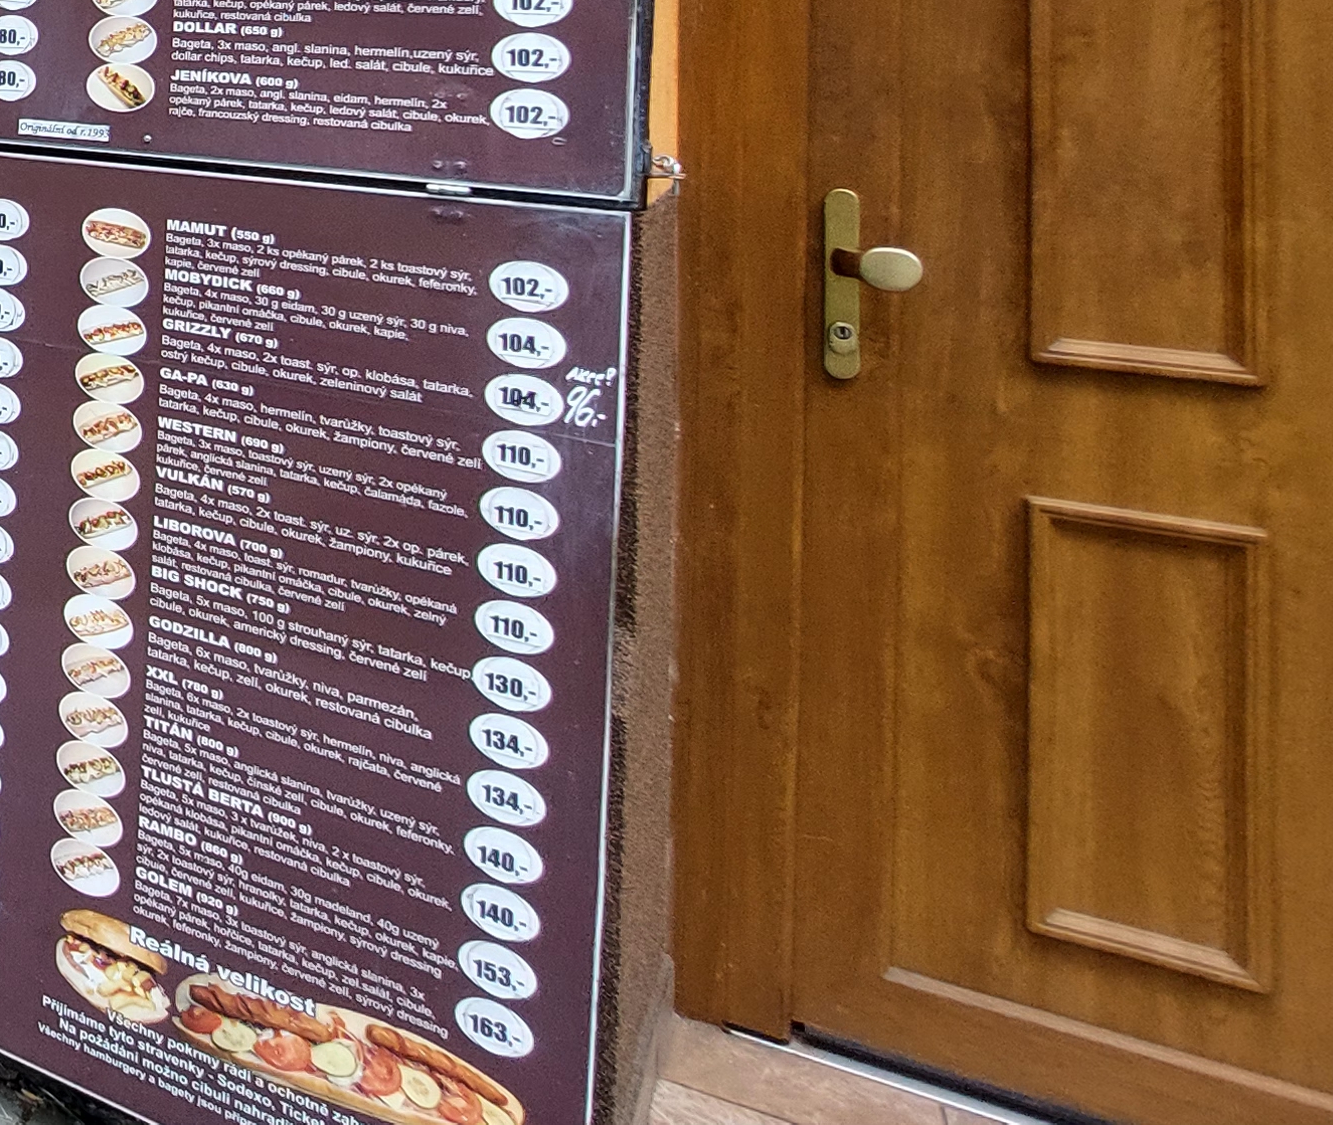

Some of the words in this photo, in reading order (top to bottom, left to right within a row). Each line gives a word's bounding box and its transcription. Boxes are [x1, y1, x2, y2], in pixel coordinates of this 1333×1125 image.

[173, 21, 236, 36] DOLLAR
[170, 69, 252, 86] JENÍKOVA
[166, 220, 228, 237] MAMUT
[164, 269, 253, 293] MOBYDICK
[162, 319, 231, 340] GRIZZLY
[498, 333, 551, 356] 104,-
[159, 369, 208, 387] GA-PA
[157, 417, 237, 443] WESTERN
[156, 467, 224, 491] VULKÁN
[153, 517, 236, 546] LIBOROVA
[151, 566, 179, 585] BIG
[184, 573, 243, 601] SHOCK
[149, 615, 231, 649] GODZILLA
[145, 665, 178, 685] XXL
[144, 715, 193, 743] TITÁN
[141, 766, 205, 799] TLUSTÁ
[208, 789, 264, 817] BERTA
[139, 816, 198, 849] RAMBO
[135, 865, 193, 897] GOLEM
[129, 926, 211, 974] Reálná
[217, 964, 317, 1017] velikost
[42, 995, 105, 1033] Přijímáme
[110, 1025, 134, 1047] tyto
[138, 1038, 204, 1077] stravenky
[469, 1013, 522, 1045] 163,-
[107, 1008, 164, 1043] Všechny
[167, 1037, 220, 1069] pokrmy
[224, 1058, 251, 1082] rádi
[267, 1079, 329, 1117] ochotně
